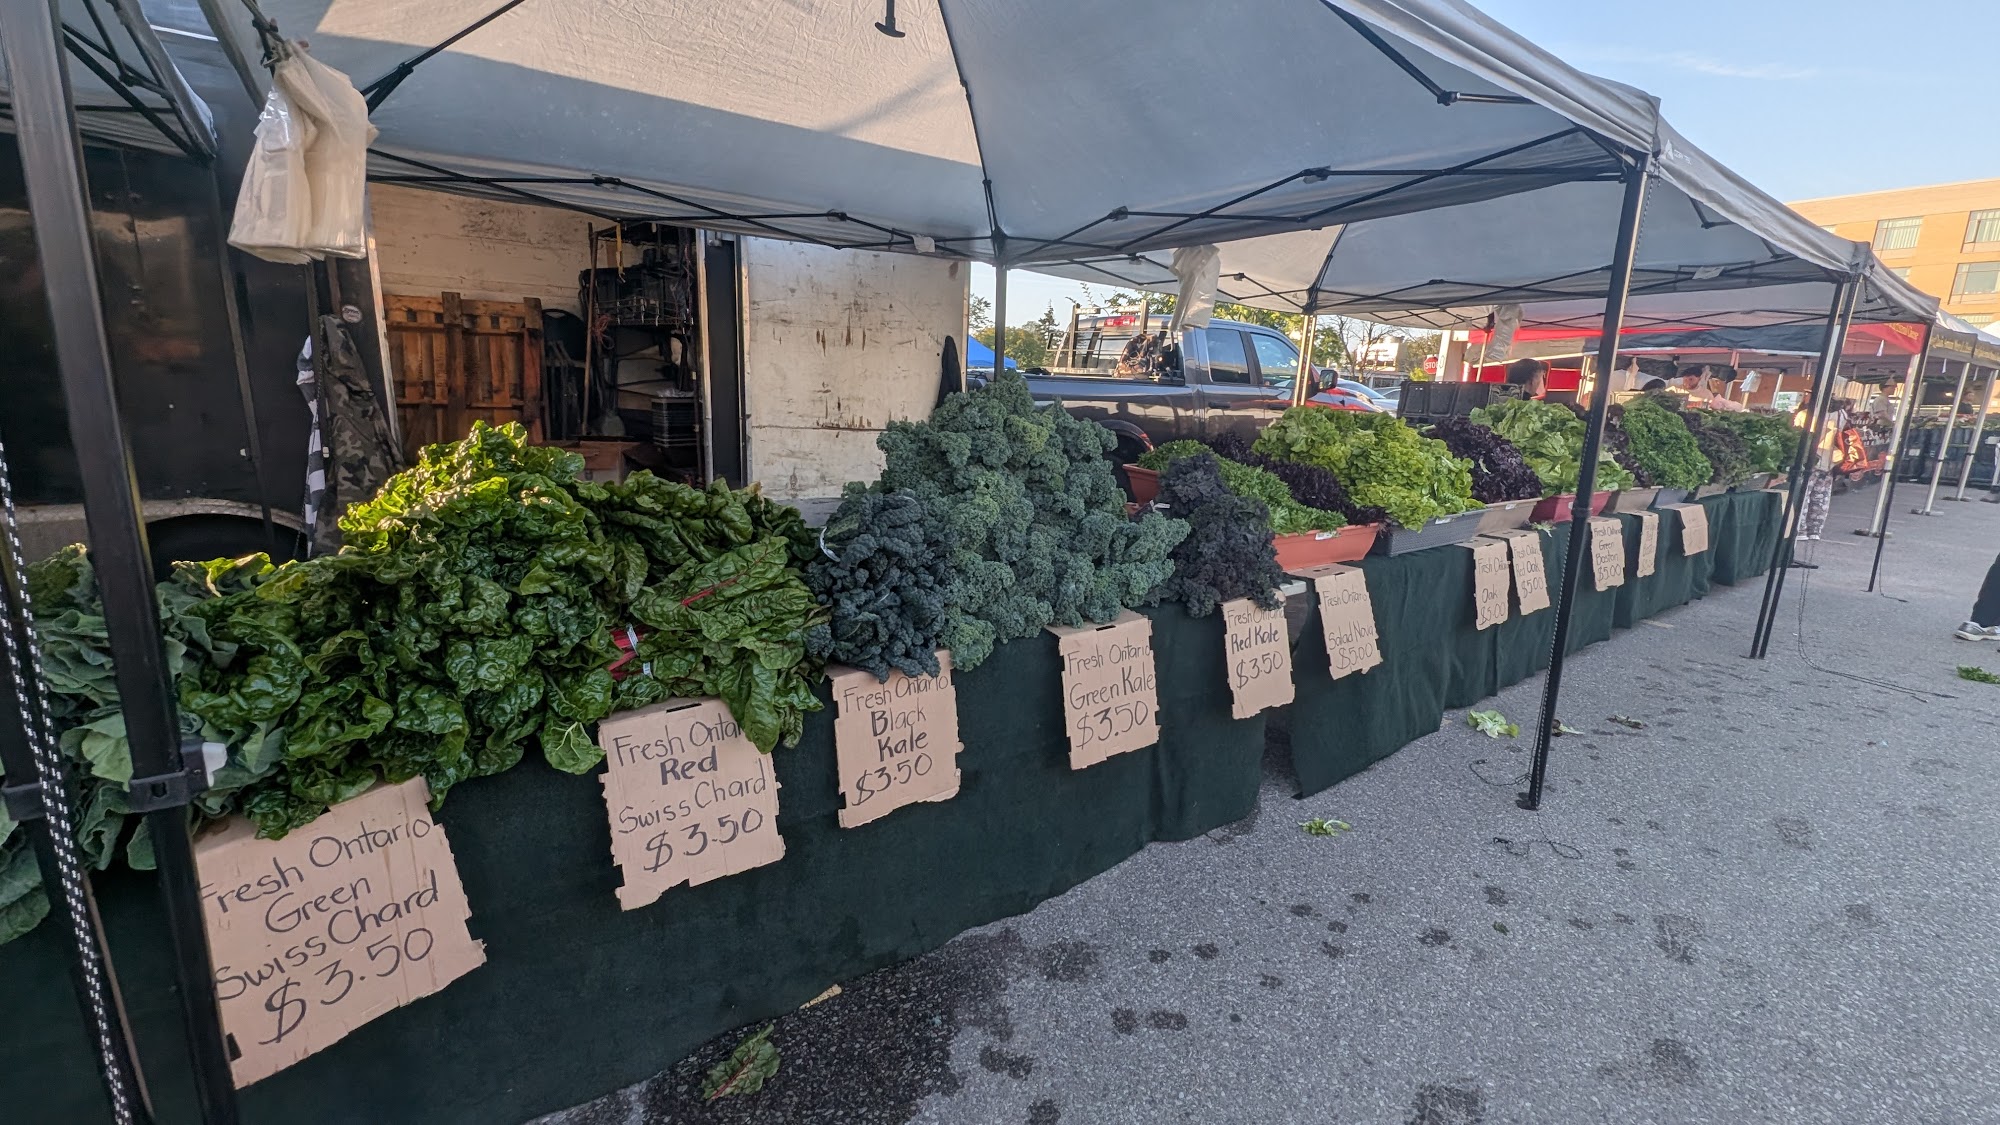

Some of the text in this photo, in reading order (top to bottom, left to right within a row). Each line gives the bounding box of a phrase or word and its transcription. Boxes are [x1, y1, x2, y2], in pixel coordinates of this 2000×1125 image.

[1595, 550, 1619, 566] Boston
[1322, 590, 1342, 612] Fresh
[1481, 584, 1498, 604] Oak
[1227, 605, 1253, 629] Fresh
[1067, 637, 1150, 676] Fresh Ontario
[1231, 623, 1280, 654] Red Kale
[1328, 626, 1354, 651] Salad
[1069, 661, 1156, 710] Green Kale
[1235, 650, 1283, 690] $3.50
[843, 676, 949, 713] Fresh Ontario
[871, 697, 927, 737] Black
[1076, 700, 1149, 750] $3.50
[612, 713, 741, 767] Fresh Onta
[877, 725, 929, 762] Kale
[660, 745, 718, 786] Red
[851, 752, 933, 806] $3.50
[618, 758, 766, 834] Swiss Chard
[309, 813, 431, 868] Ontario
[643, 807, 763, 873] $3.50
[265, 877, 371, 933] Green
[214, 869, 439, 1001] Swiss Chard
